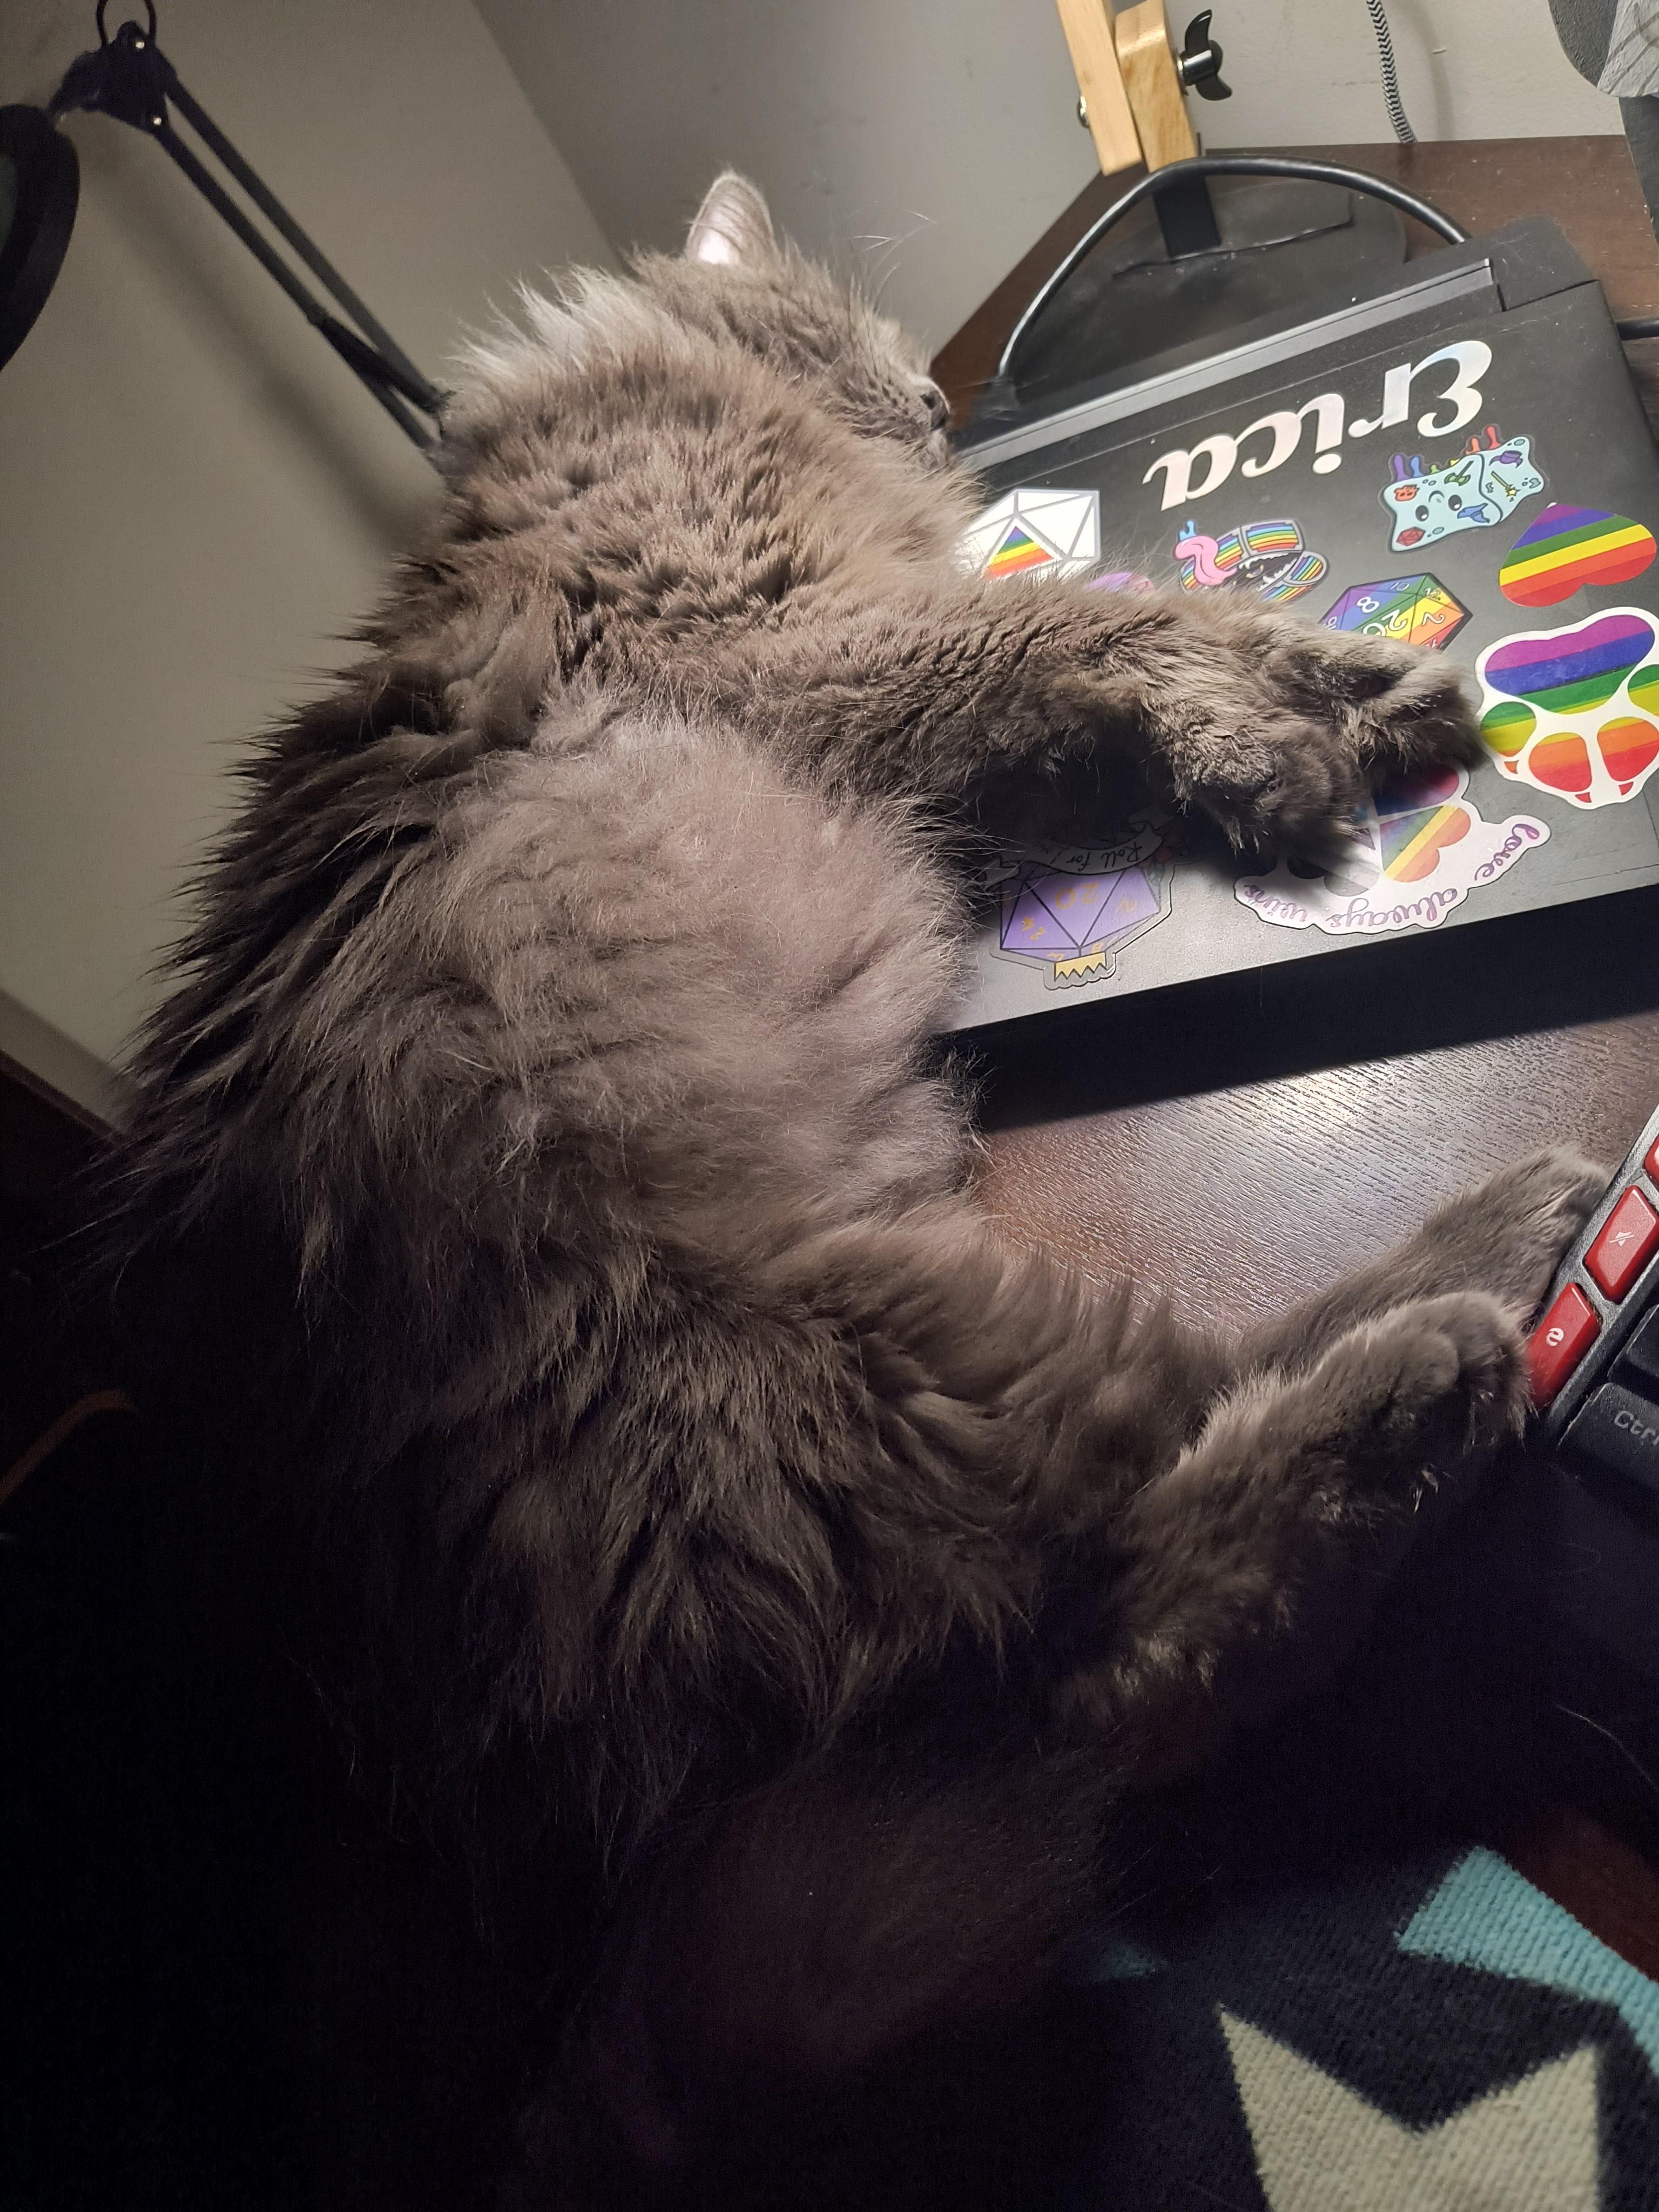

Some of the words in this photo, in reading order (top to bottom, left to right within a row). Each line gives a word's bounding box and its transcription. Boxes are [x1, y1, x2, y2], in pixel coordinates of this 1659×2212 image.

[1142, 341, 1492, 511] Erica
[1389, 581, 1409, 591] 10
[1356, 596, 1379, 613] 8
[1363, 609, 1408, 636] 20
[1421, 612, 1445, 627] 2
[1065, 852, 1090, 871] for
[1101, 842, 1144, 868] Roll
[1475, 824, 1540, 881] love
[1054, 881, 1098, 910] 20
[1244, 884, 1307, 922] wins
[1325, 888, 1458, 928] always
